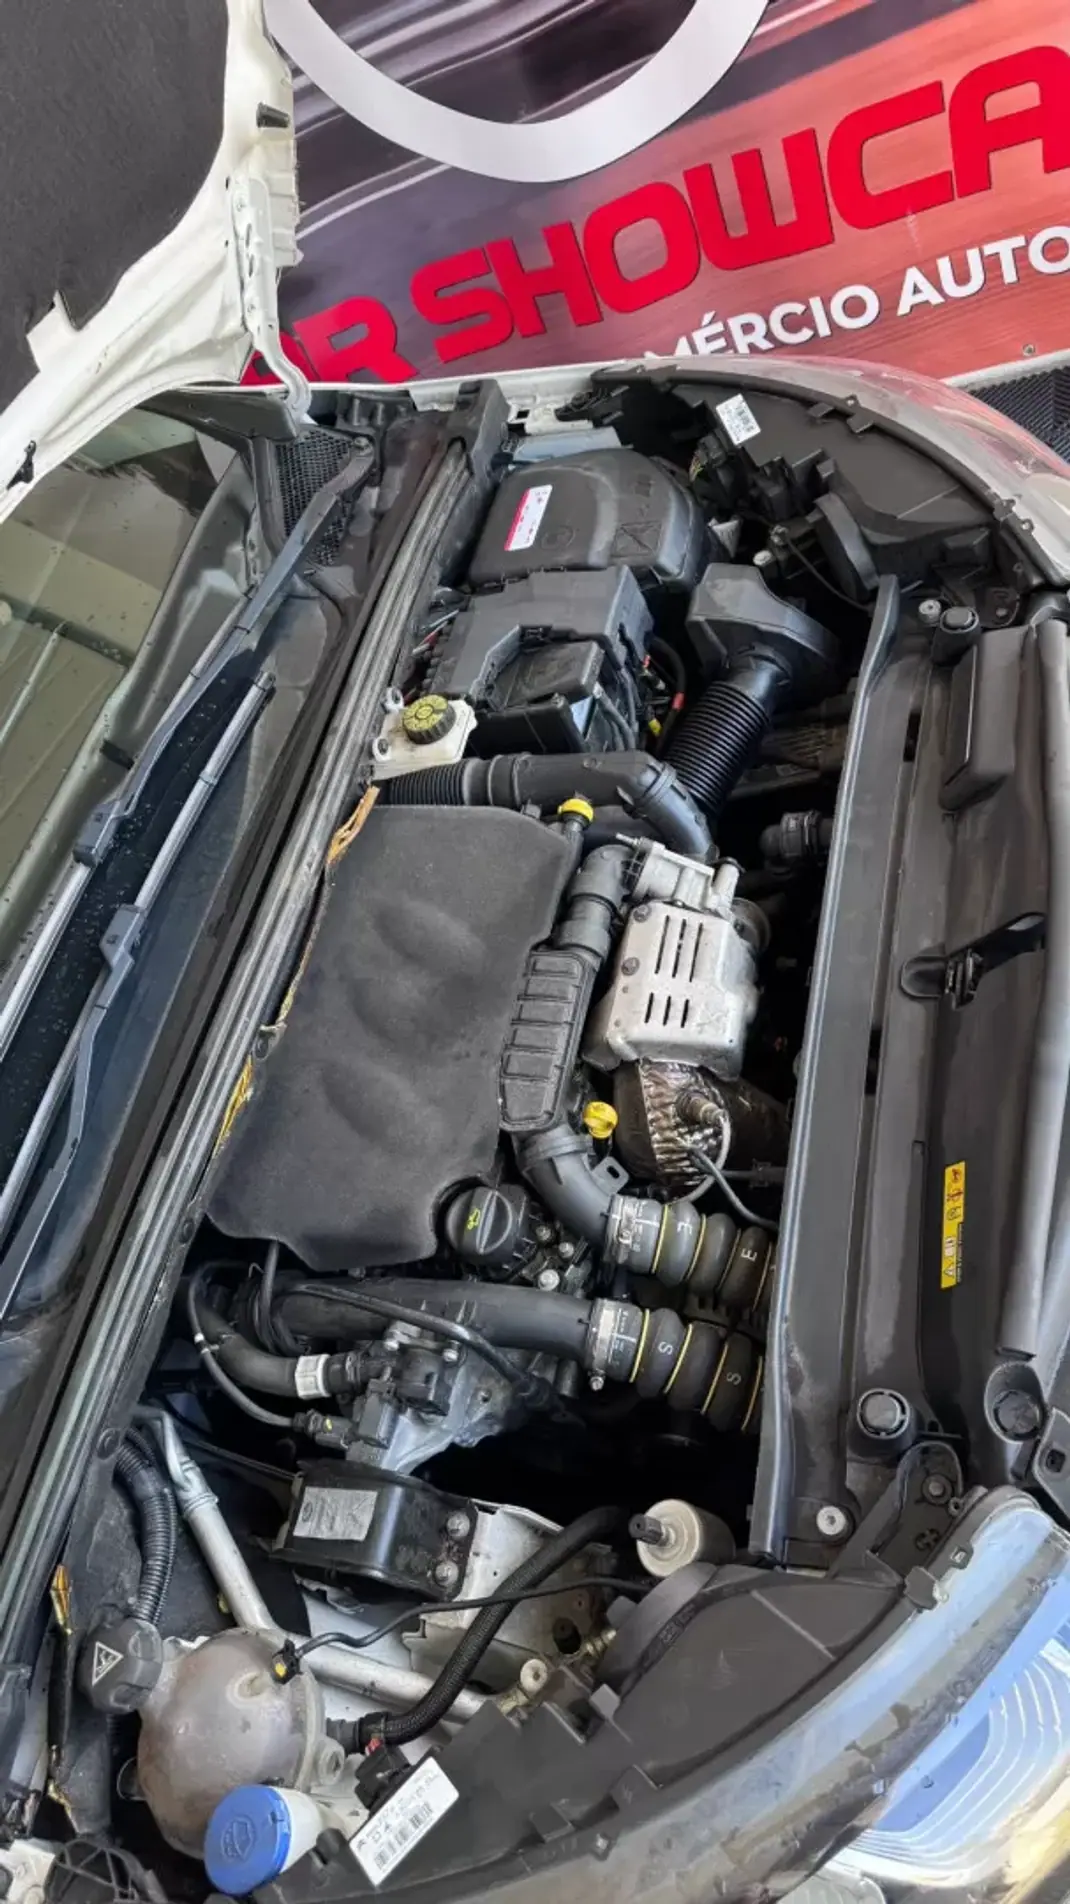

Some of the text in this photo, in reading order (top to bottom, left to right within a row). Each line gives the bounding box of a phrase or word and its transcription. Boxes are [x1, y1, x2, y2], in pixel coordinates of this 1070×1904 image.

[411, 45, 1070, 364] SHOWCA
[896, 225, 1070, 316] AUTO
[678, 1221, 757, 1261] E E
[659, 1343, 742, 1385] S S
